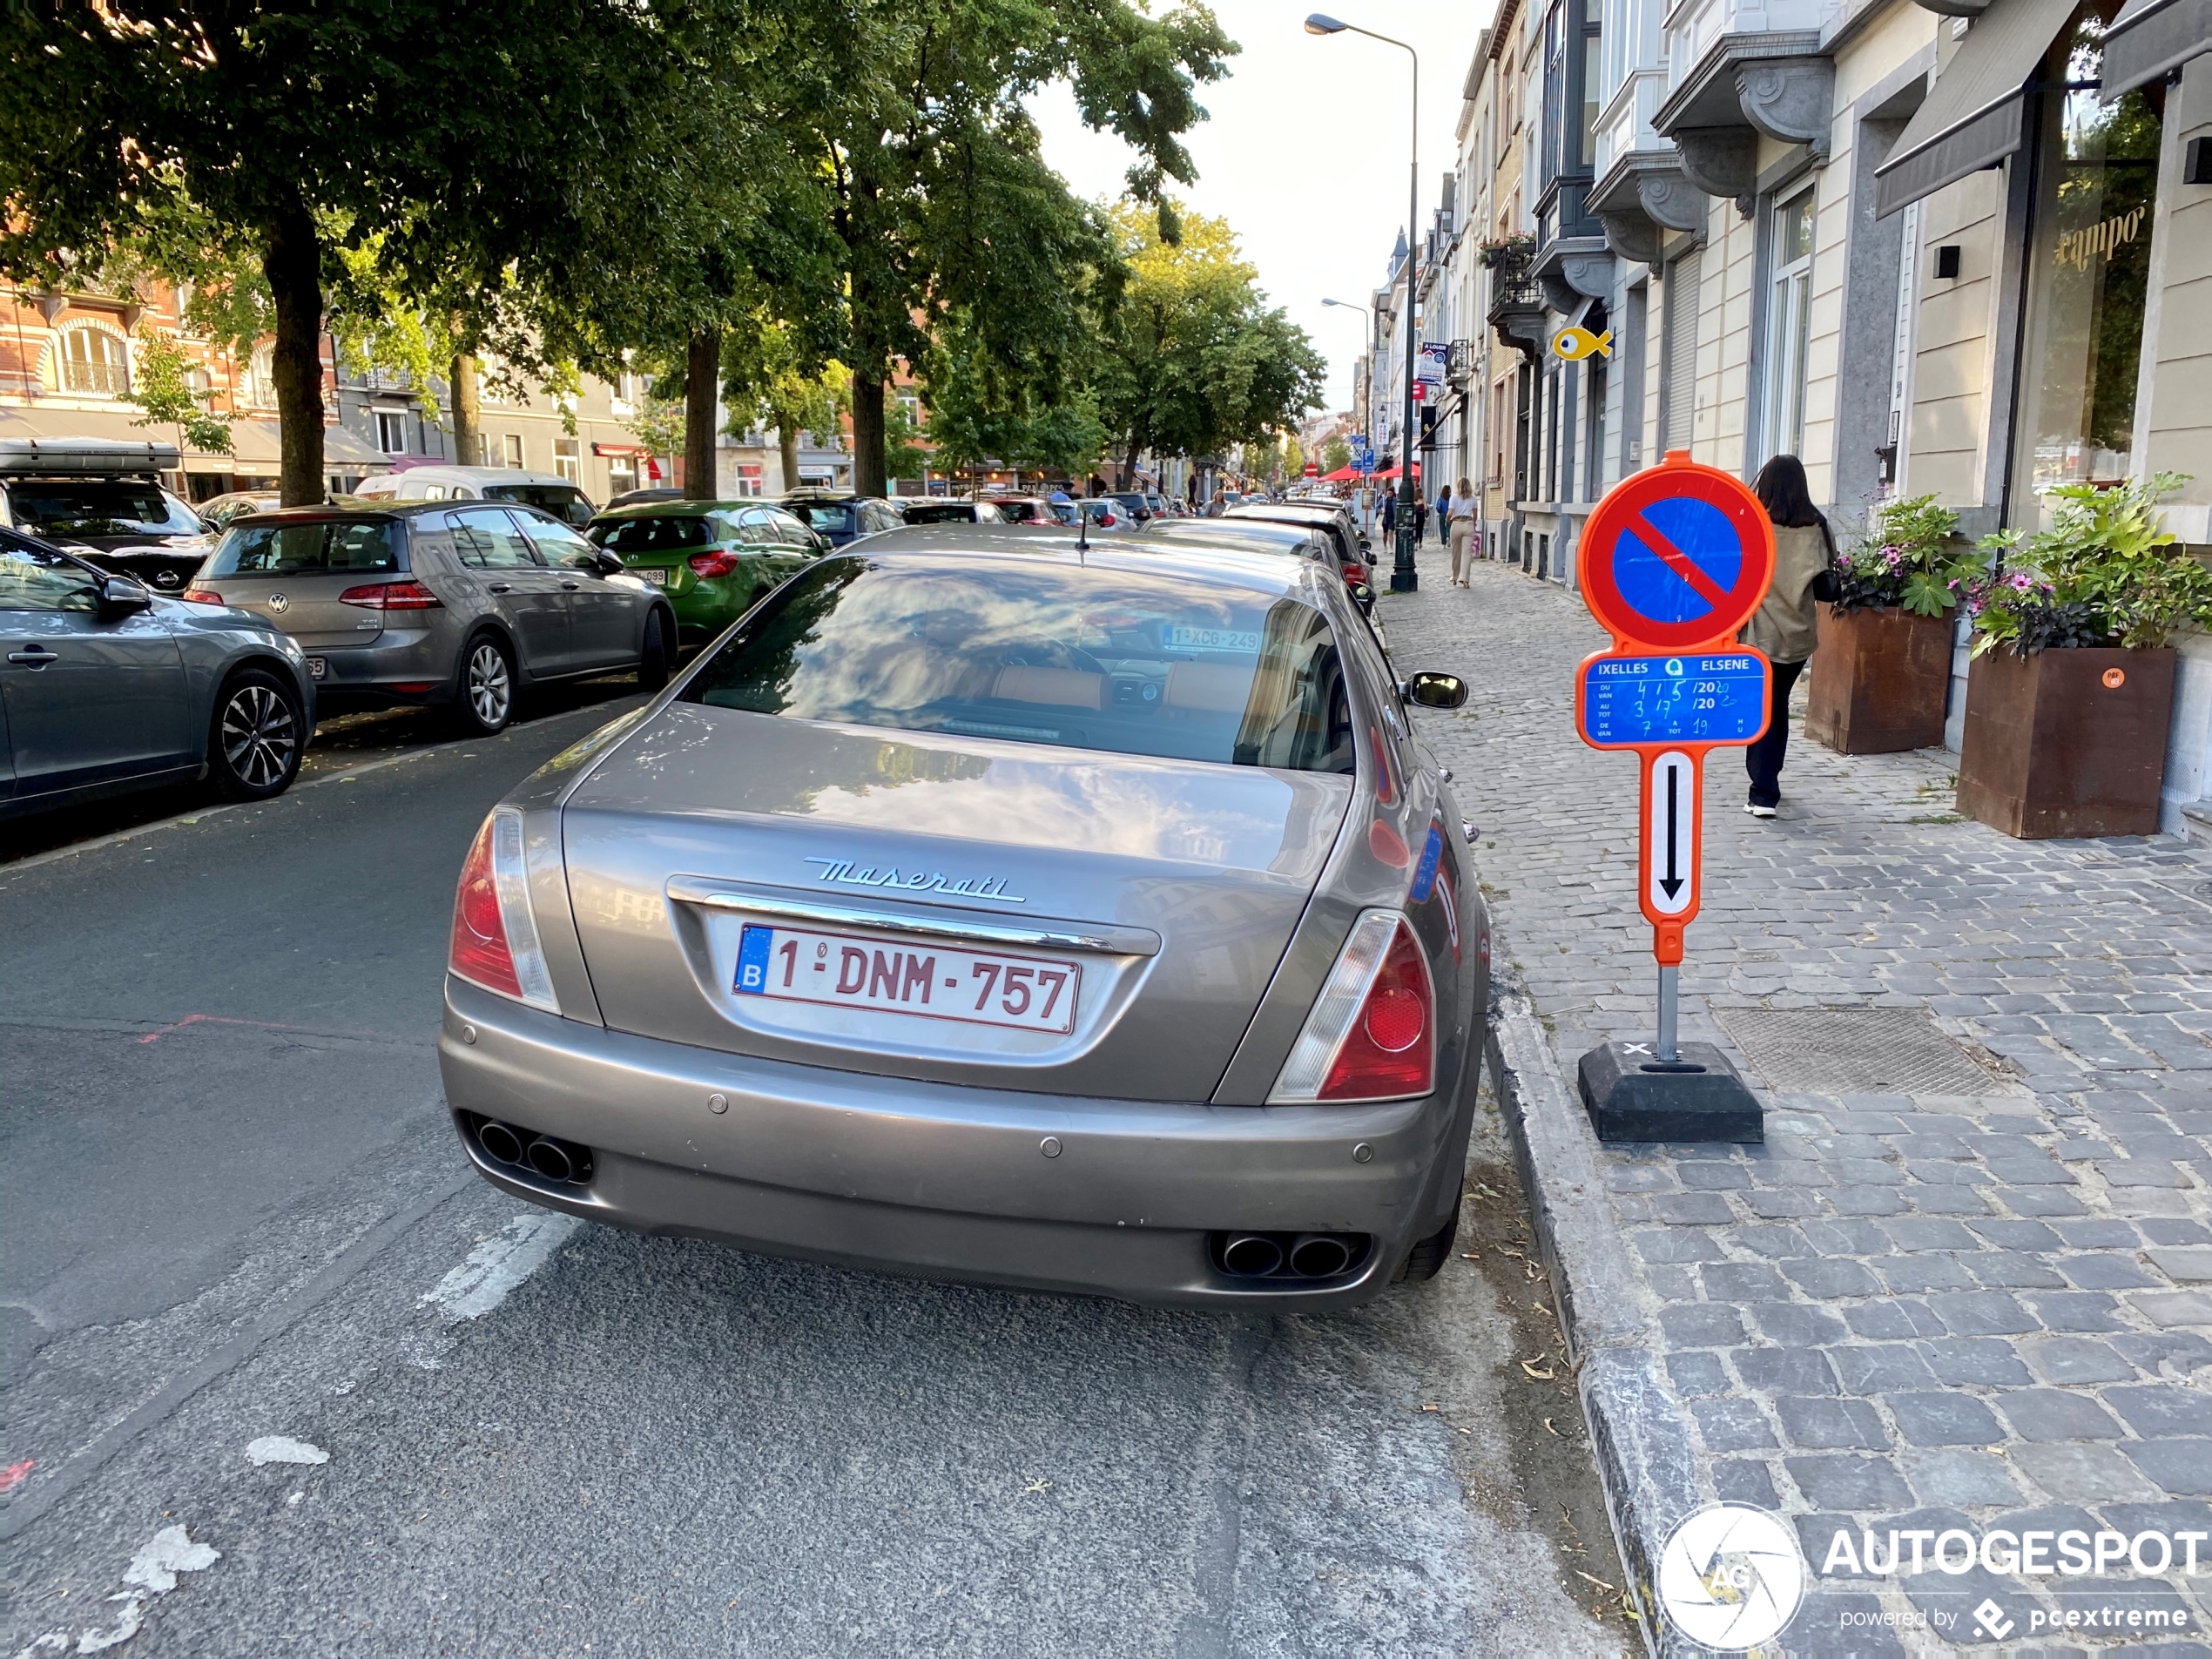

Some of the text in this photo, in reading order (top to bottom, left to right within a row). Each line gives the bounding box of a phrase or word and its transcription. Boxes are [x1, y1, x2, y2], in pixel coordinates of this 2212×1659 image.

[2059, 206, 2145, 272] campo
[1365, 450, 1372, 461] P
[1598, 658, 1750, 675] IXELLES ELSENE
[804, 856, 1026, 902] Maserati
[743, 964, 761, 987] B
